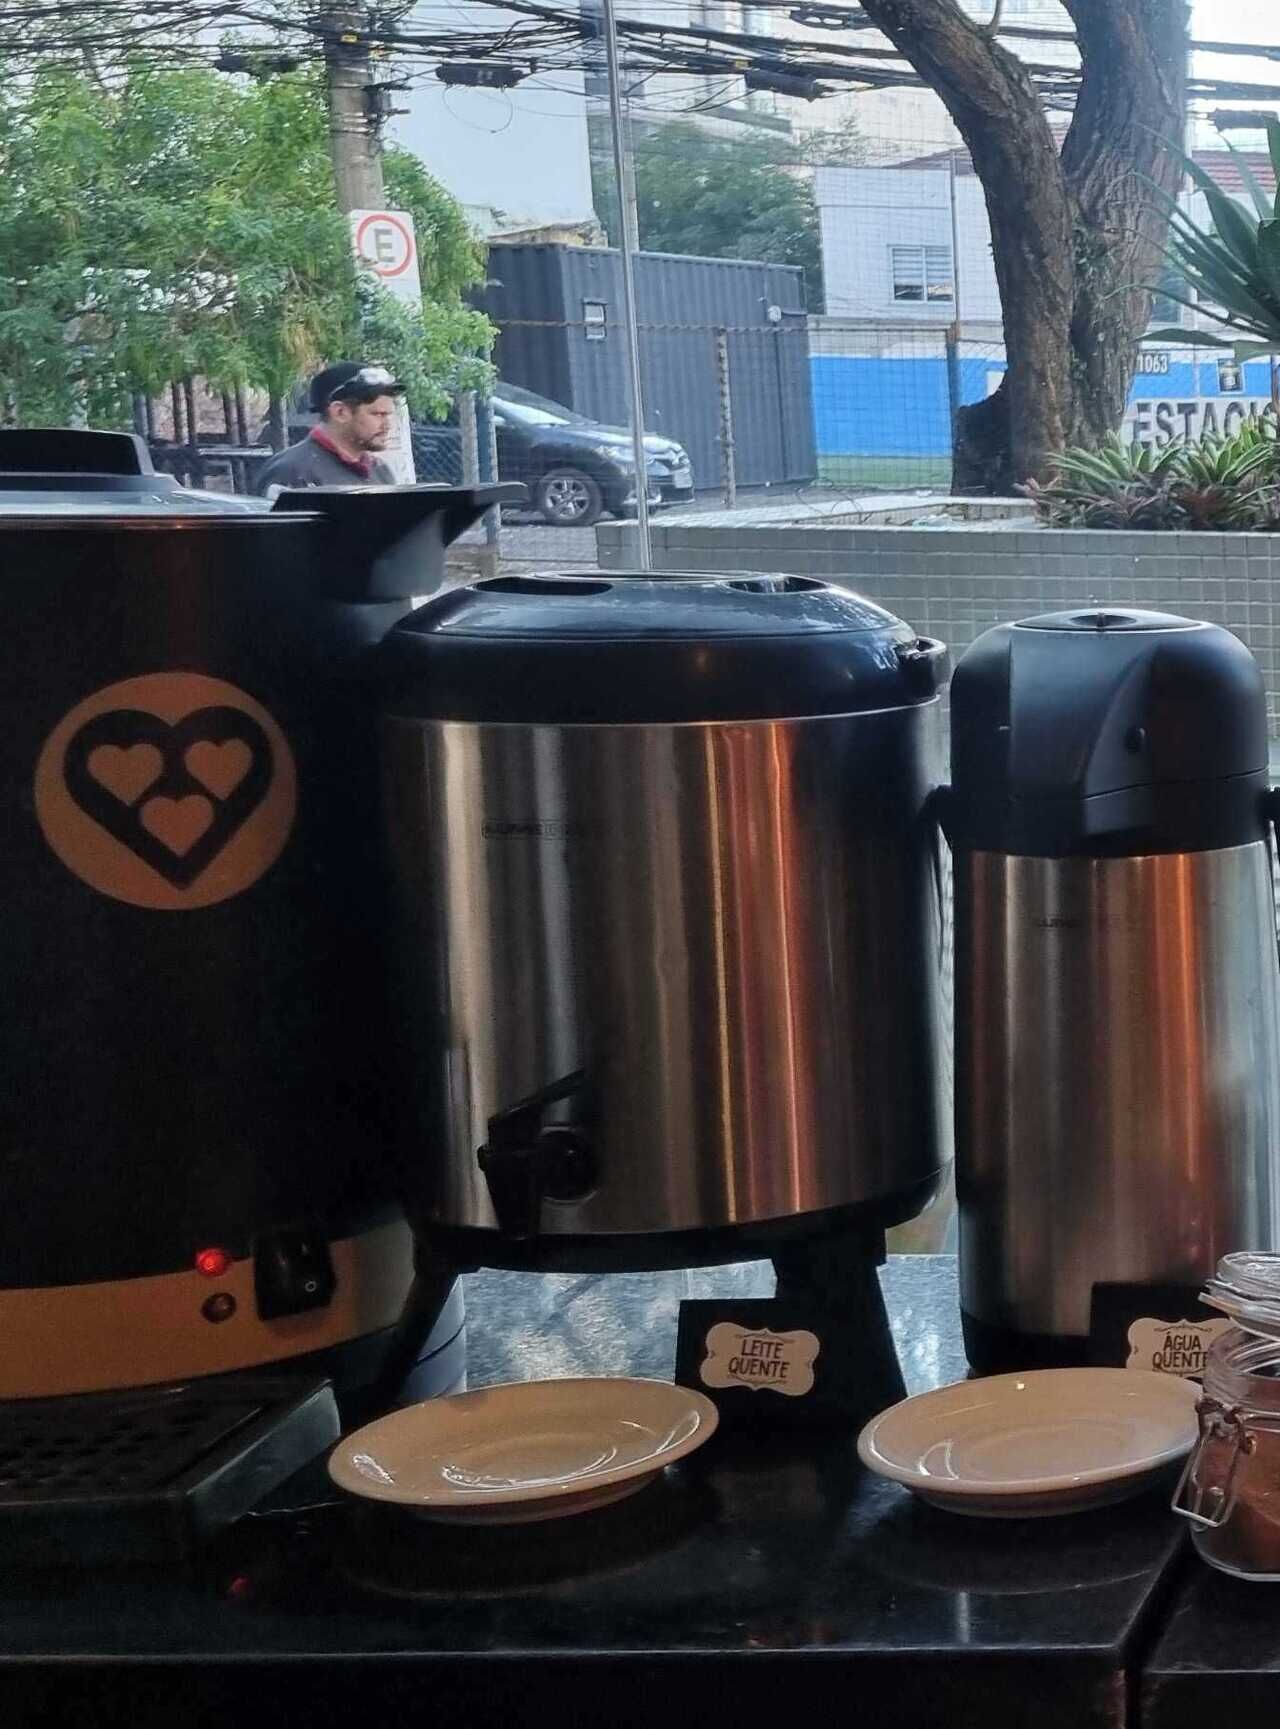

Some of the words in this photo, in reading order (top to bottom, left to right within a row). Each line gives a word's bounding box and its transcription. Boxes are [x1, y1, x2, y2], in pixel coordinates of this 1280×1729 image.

[374, 228, 395, 263] E
[1136, 354, 1168, 374] 1063
[741, 1338, 784, 1359] LEITE
[1163, 1331, 1202, 1351] ÁGUA
[728, 1356, 791, 1378] QUENTE
